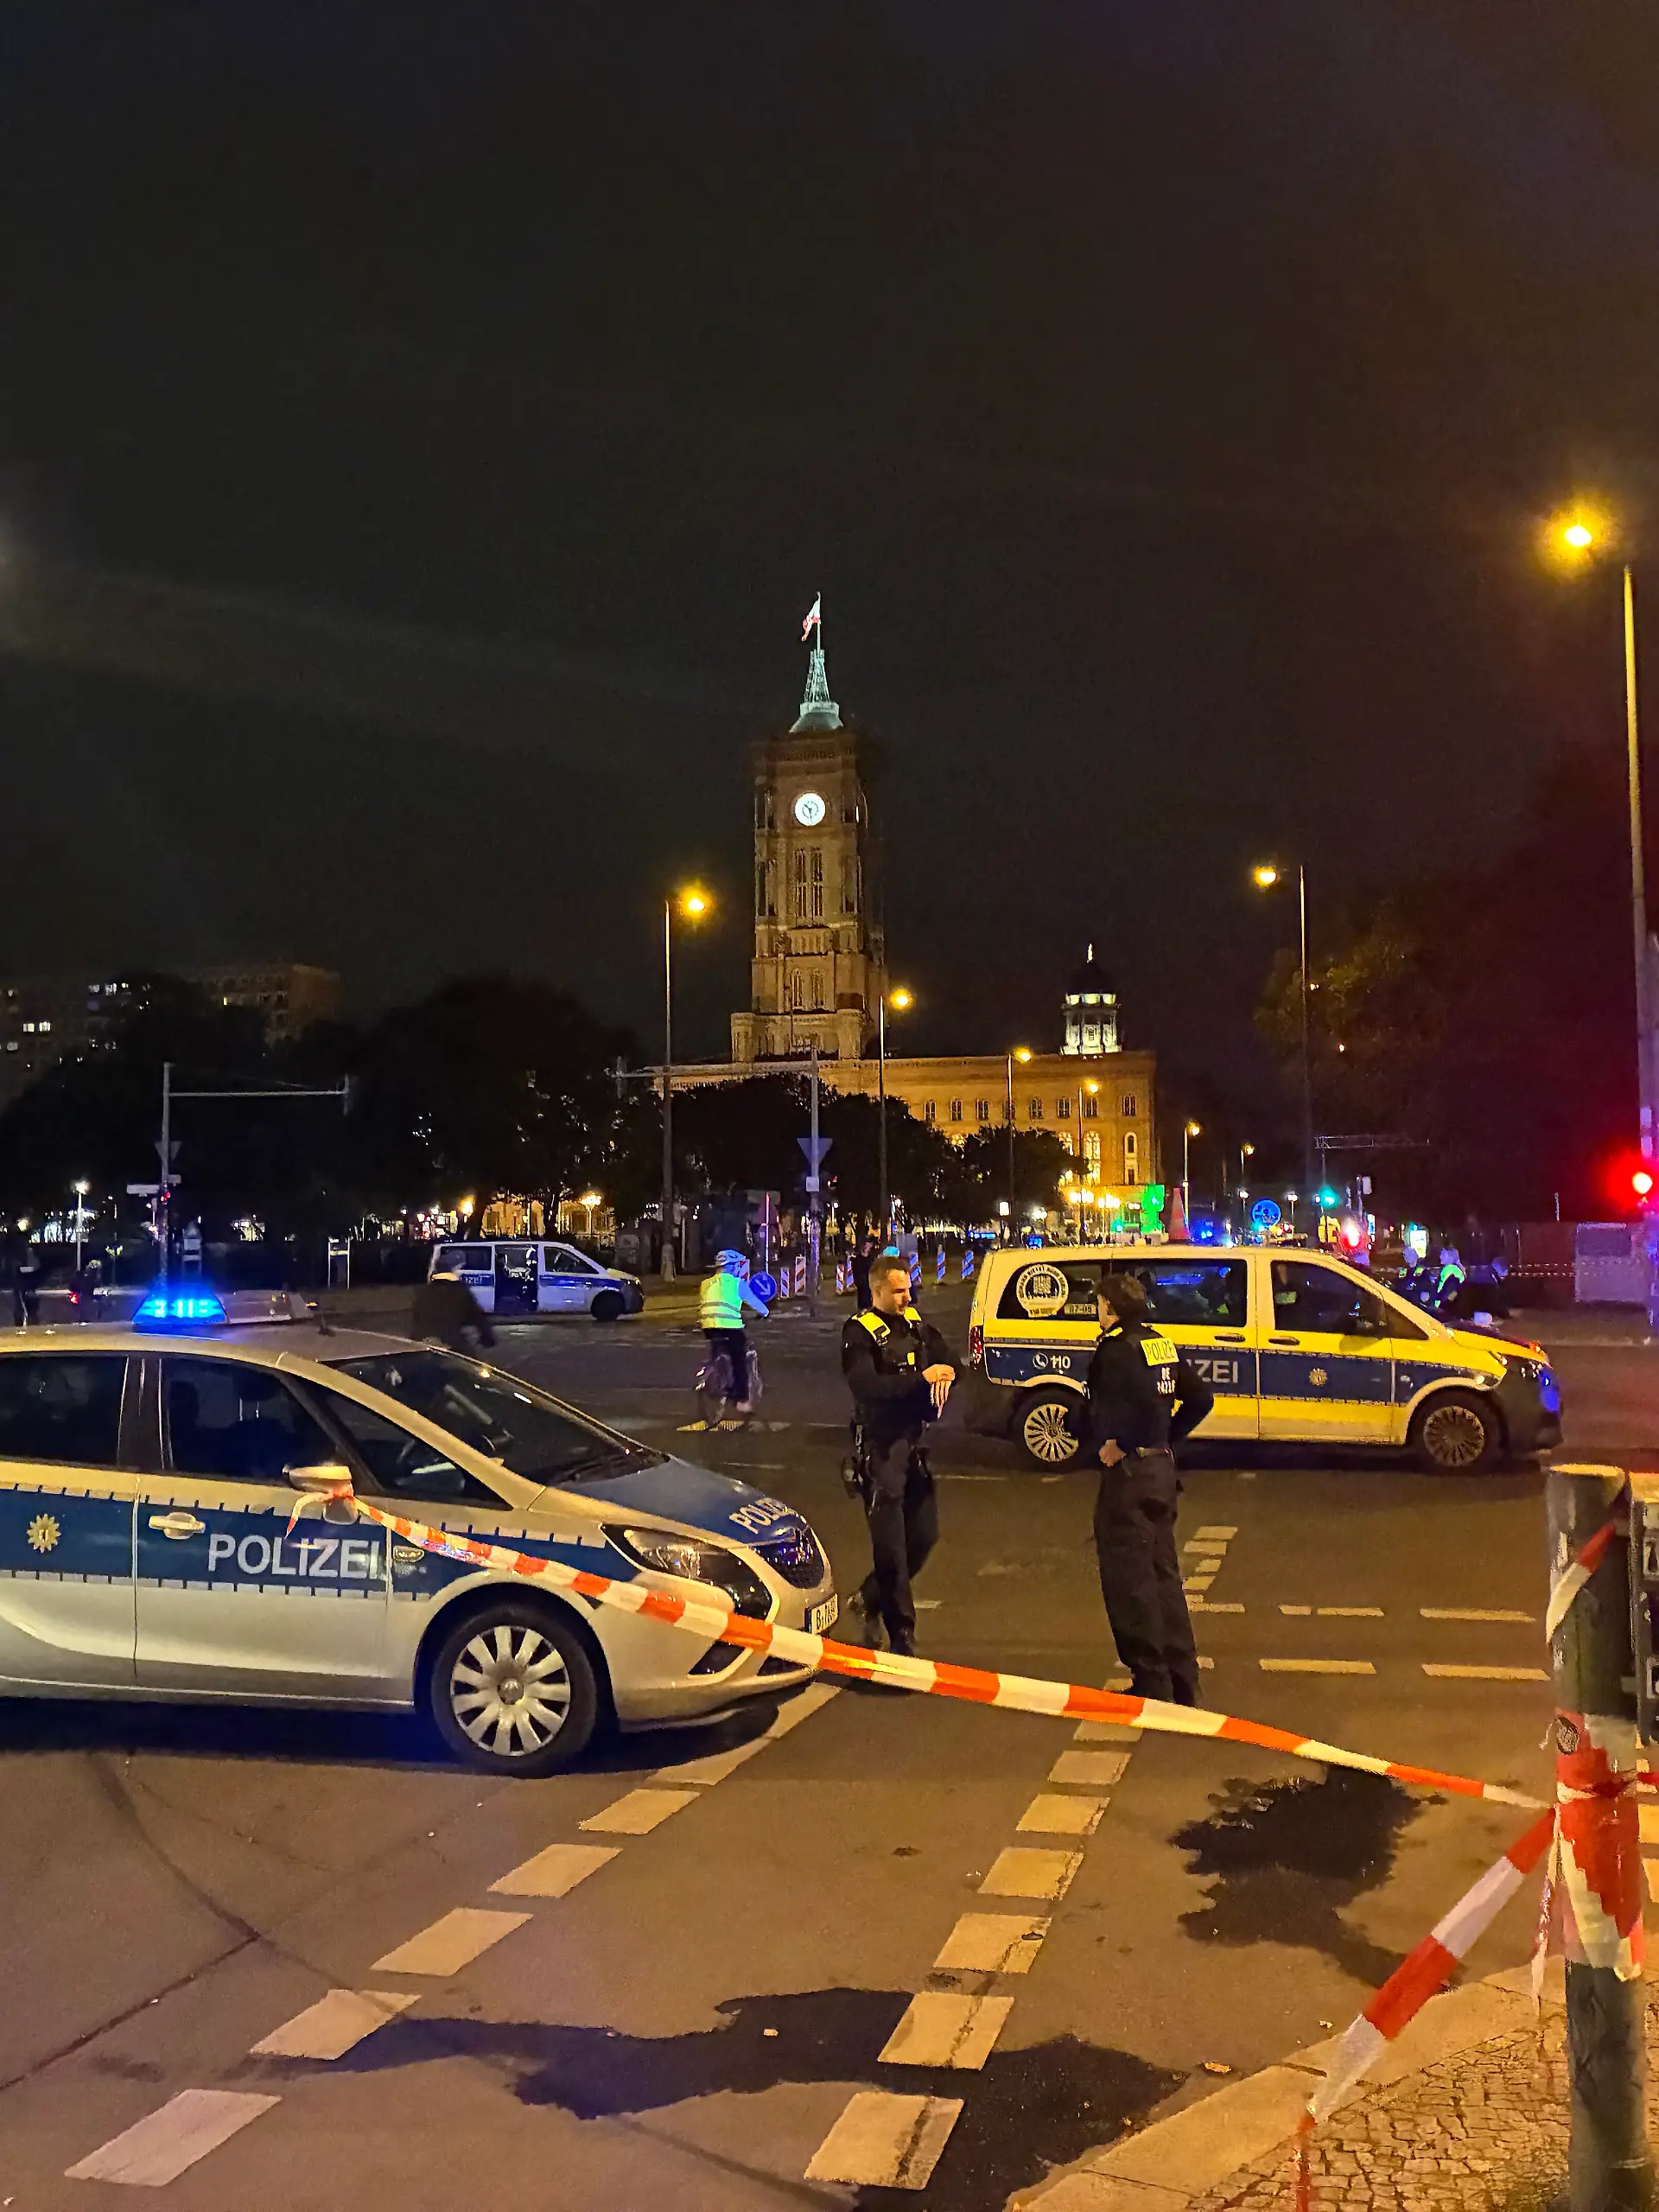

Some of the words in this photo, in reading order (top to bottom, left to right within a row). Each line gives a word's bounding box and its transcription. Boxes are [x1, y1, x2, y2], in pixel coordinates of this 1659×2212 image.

[1050, 1354, 1071, 1370] 110
[1186, 1358, 1238, 1383] ZEI
[207, 1533, 380, 1580] POLIZEI
